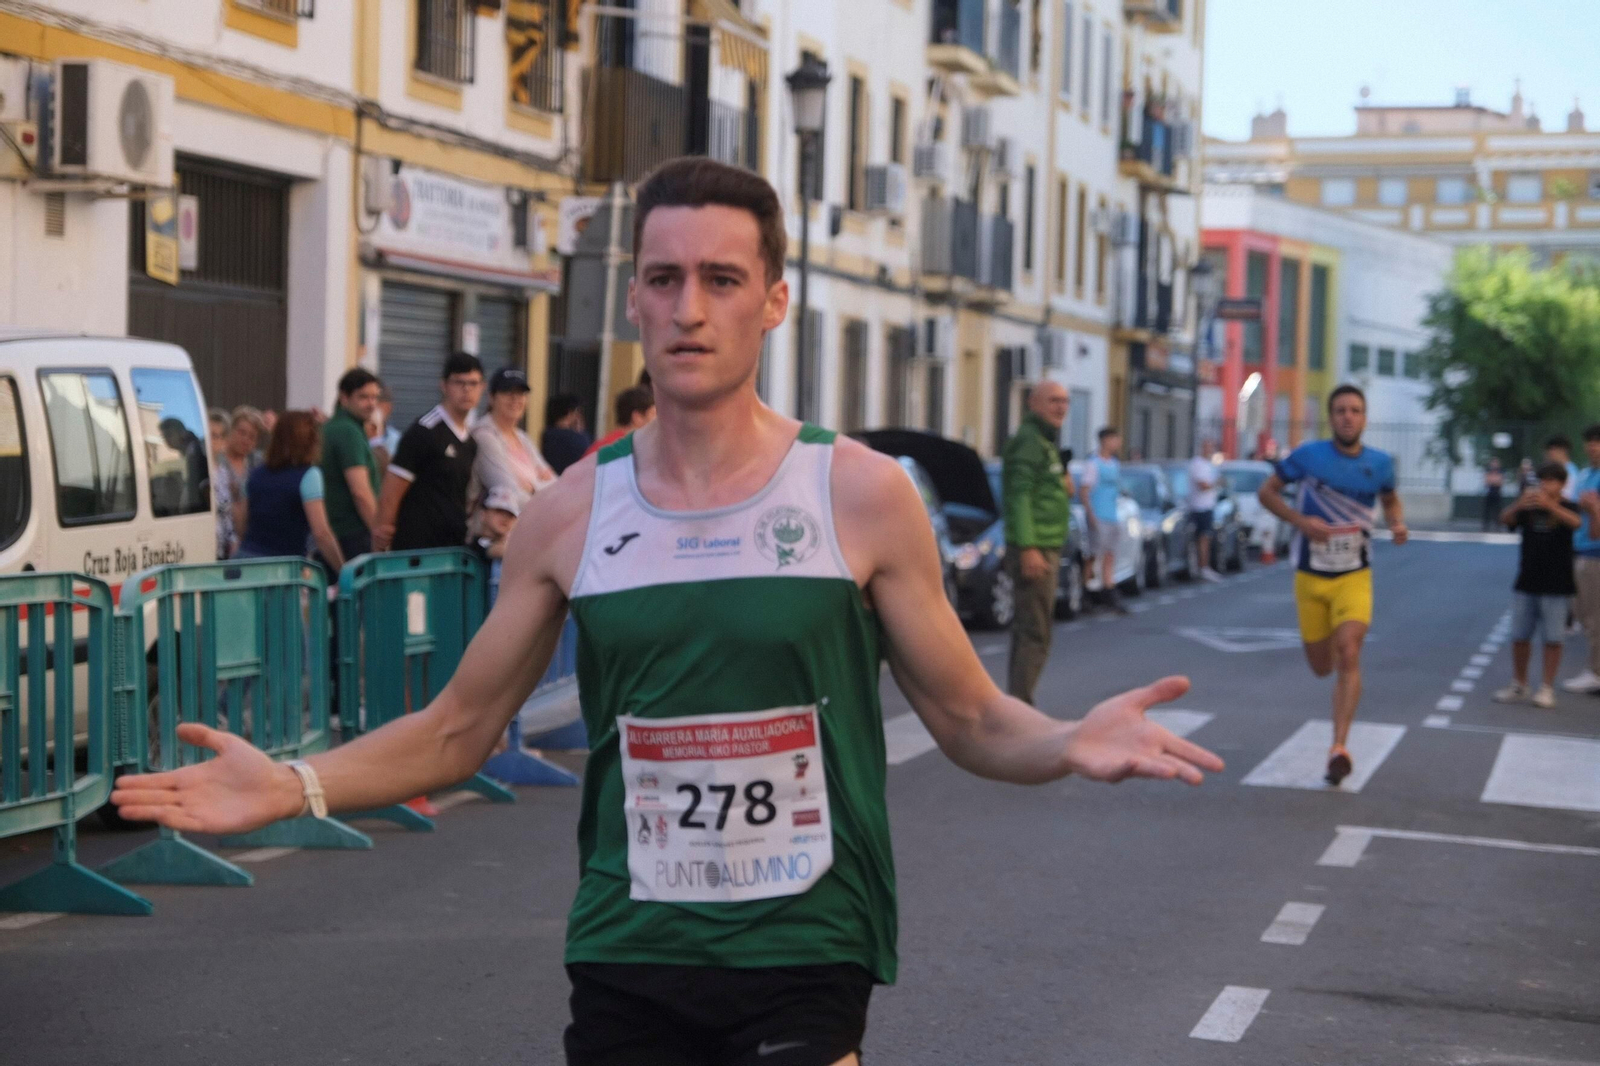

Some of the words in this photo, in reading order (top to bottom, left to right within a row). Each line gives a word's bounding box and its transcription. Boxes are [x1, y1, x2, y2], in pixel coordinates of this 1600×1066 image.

[676, 537, 699, 550] SIG
[703, 537, 740, 549] Laboral
[83, 550, 110, 575] Cruz
[115, 546, 137, 577] Roja
[642, 729, 693, 746] CARRERA
[732, 718, 806, 740] AUXILIADORA
[662, 744, 707, 759] MEMORIAL
[708, 742, 730, 757] KIKO
[732, 740, 769, 756] PASTOR
[676, 780, 777, 831] 278
